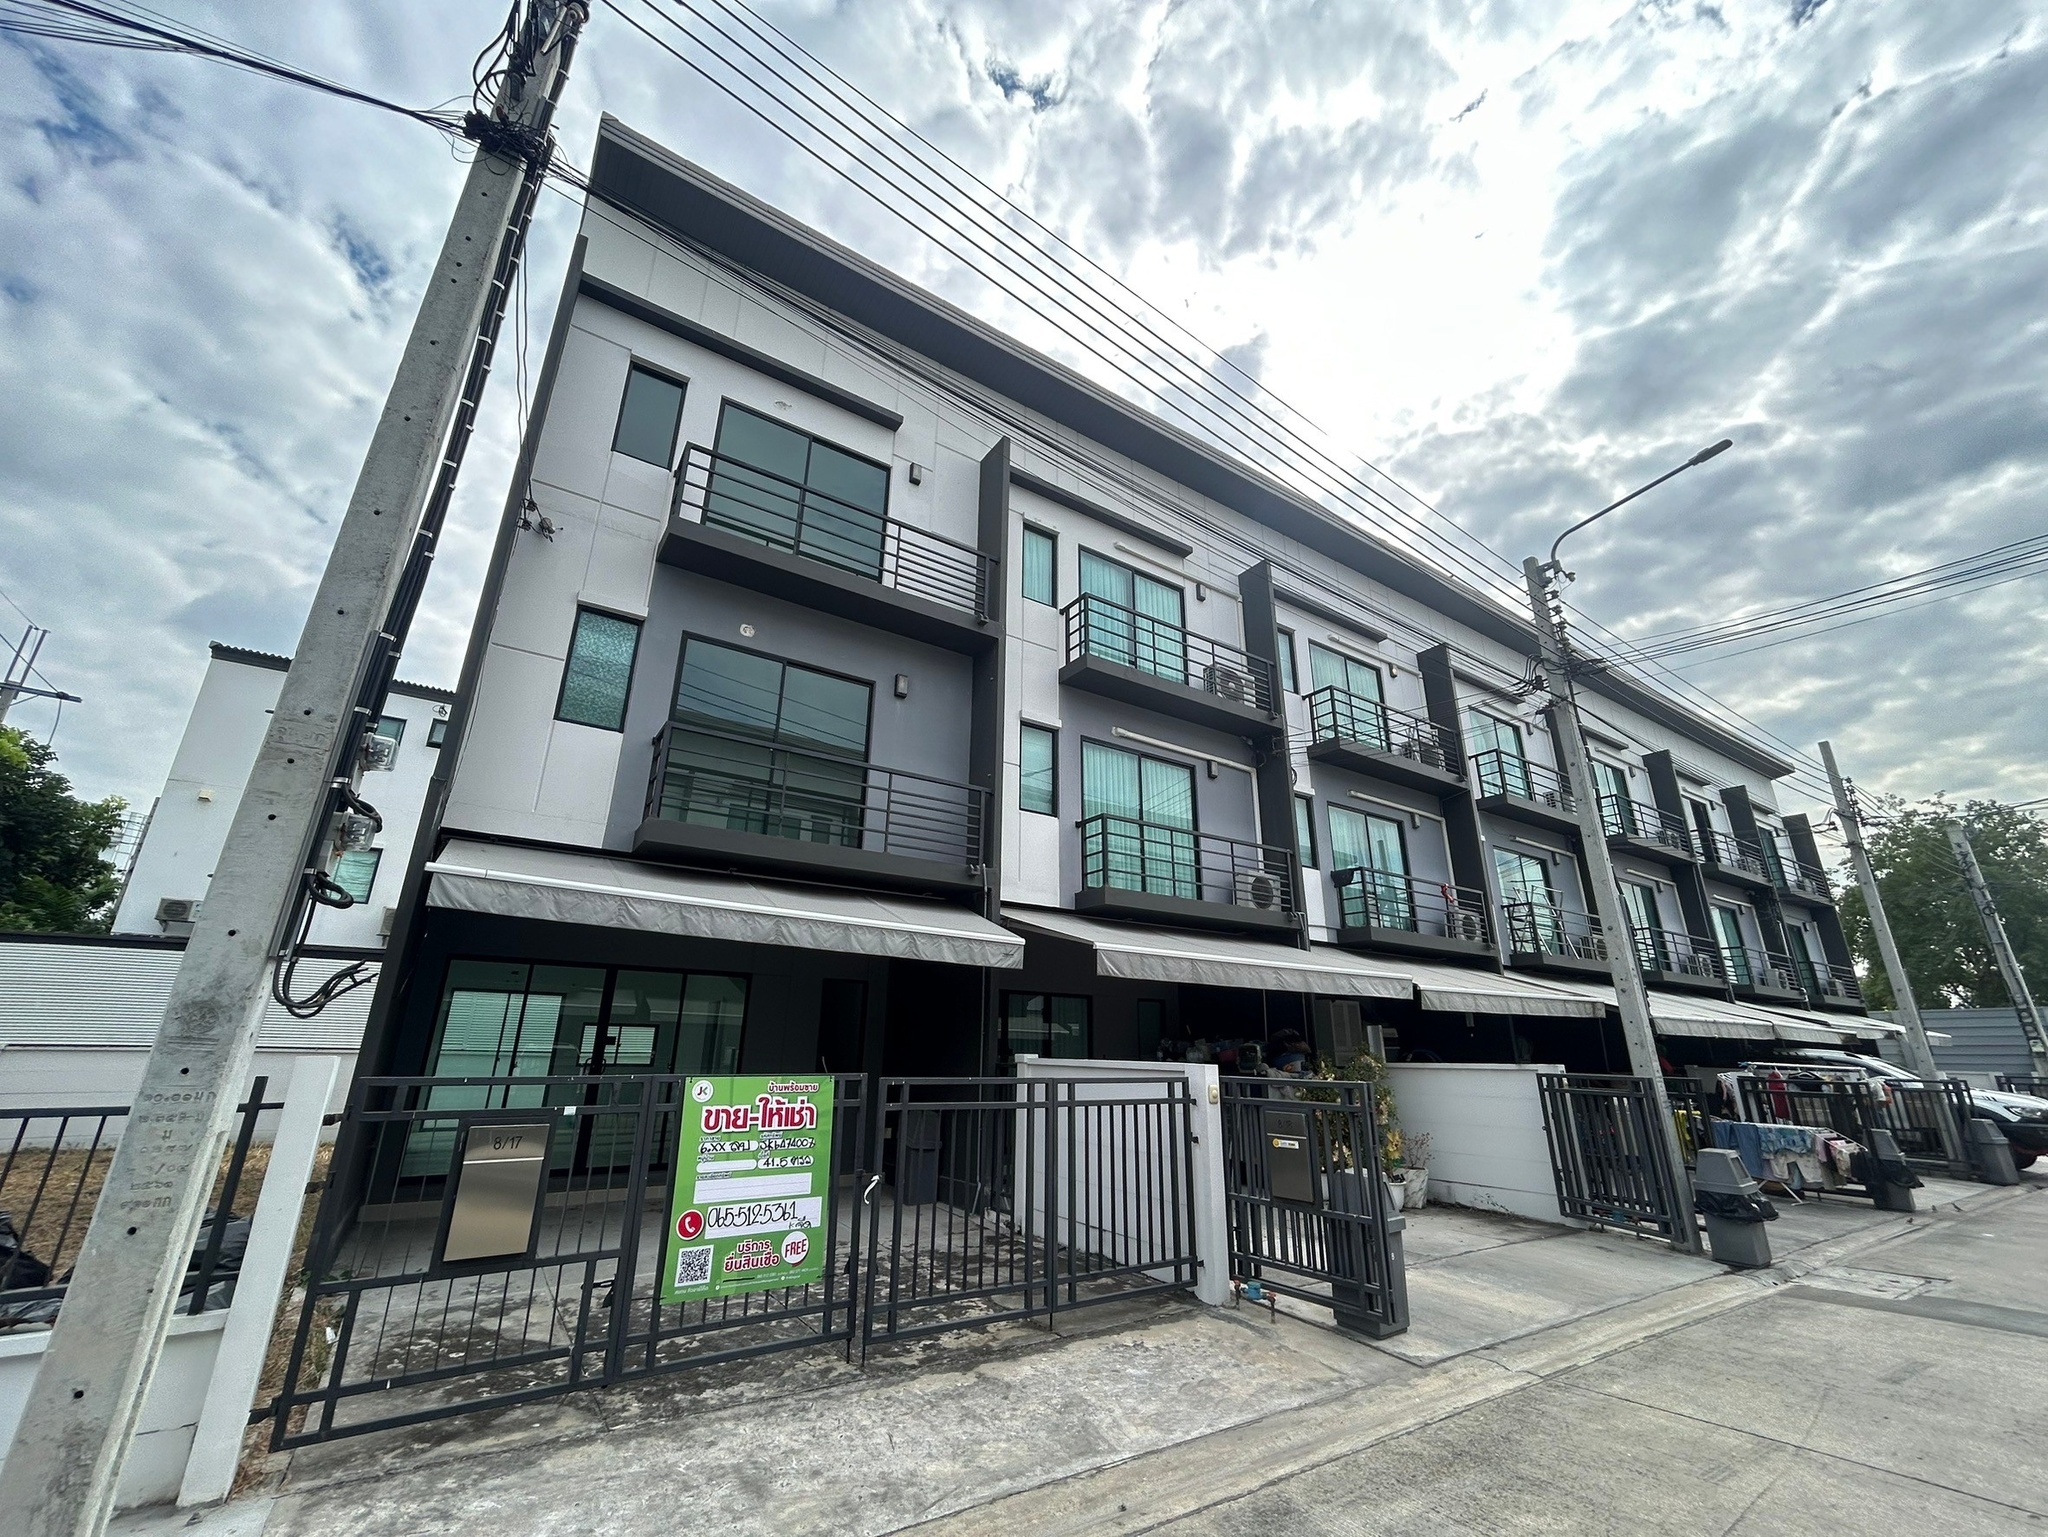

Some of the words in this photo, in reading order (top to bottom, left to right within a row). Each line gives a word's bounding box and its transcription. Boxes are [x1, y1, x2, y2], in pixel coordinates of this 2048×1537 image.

[703, 1096, 815, 1131] ขาย-ให้เช่า
[493, 1135, 523, 1151] 8/17
[763, 1156, 788, 1168] 41.5
[707, 1200, 798, 1228] 065-512-5361
[738, 1239, 772, 1253] บริการ
[784, 1238, 808, 1259] FREE
[724, 1247, 780, 1272] ยื่นสินเชื่อ
